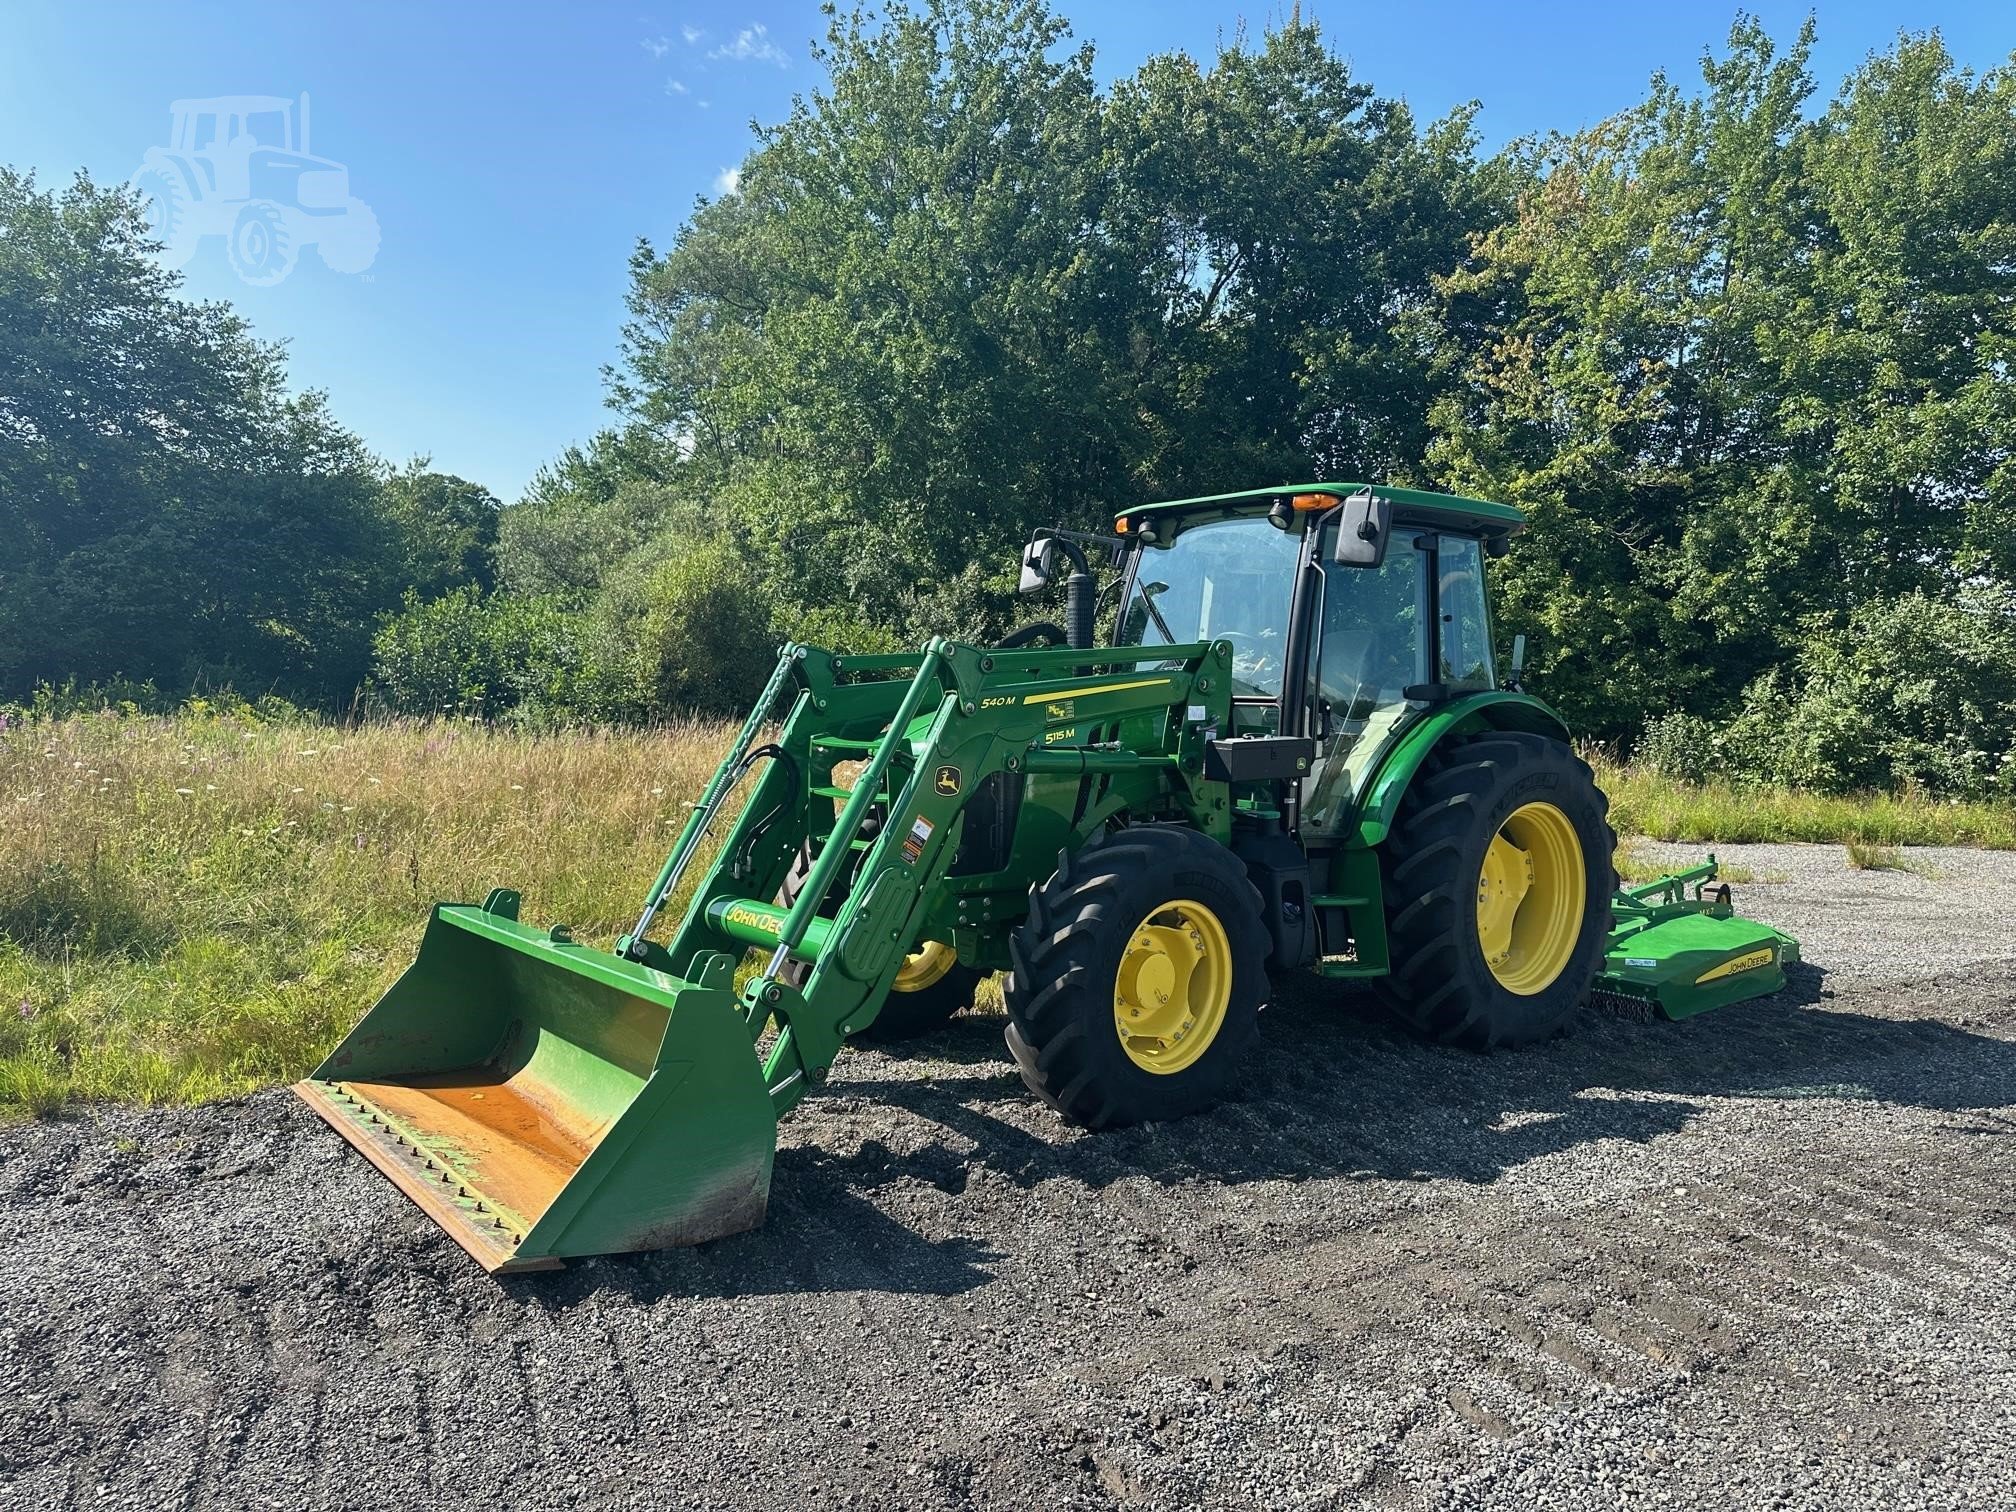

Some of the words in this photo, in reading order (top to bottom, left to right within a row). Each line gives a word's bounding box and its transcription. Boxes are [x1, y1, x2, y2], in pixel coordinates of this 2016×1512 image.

[726, 905, 759, 928] JOHN
[758, 914, 784, 935] DEE
[1728, 961, 1747, 974] JOHN
[1747, 954, 1769, 968] DEERE
